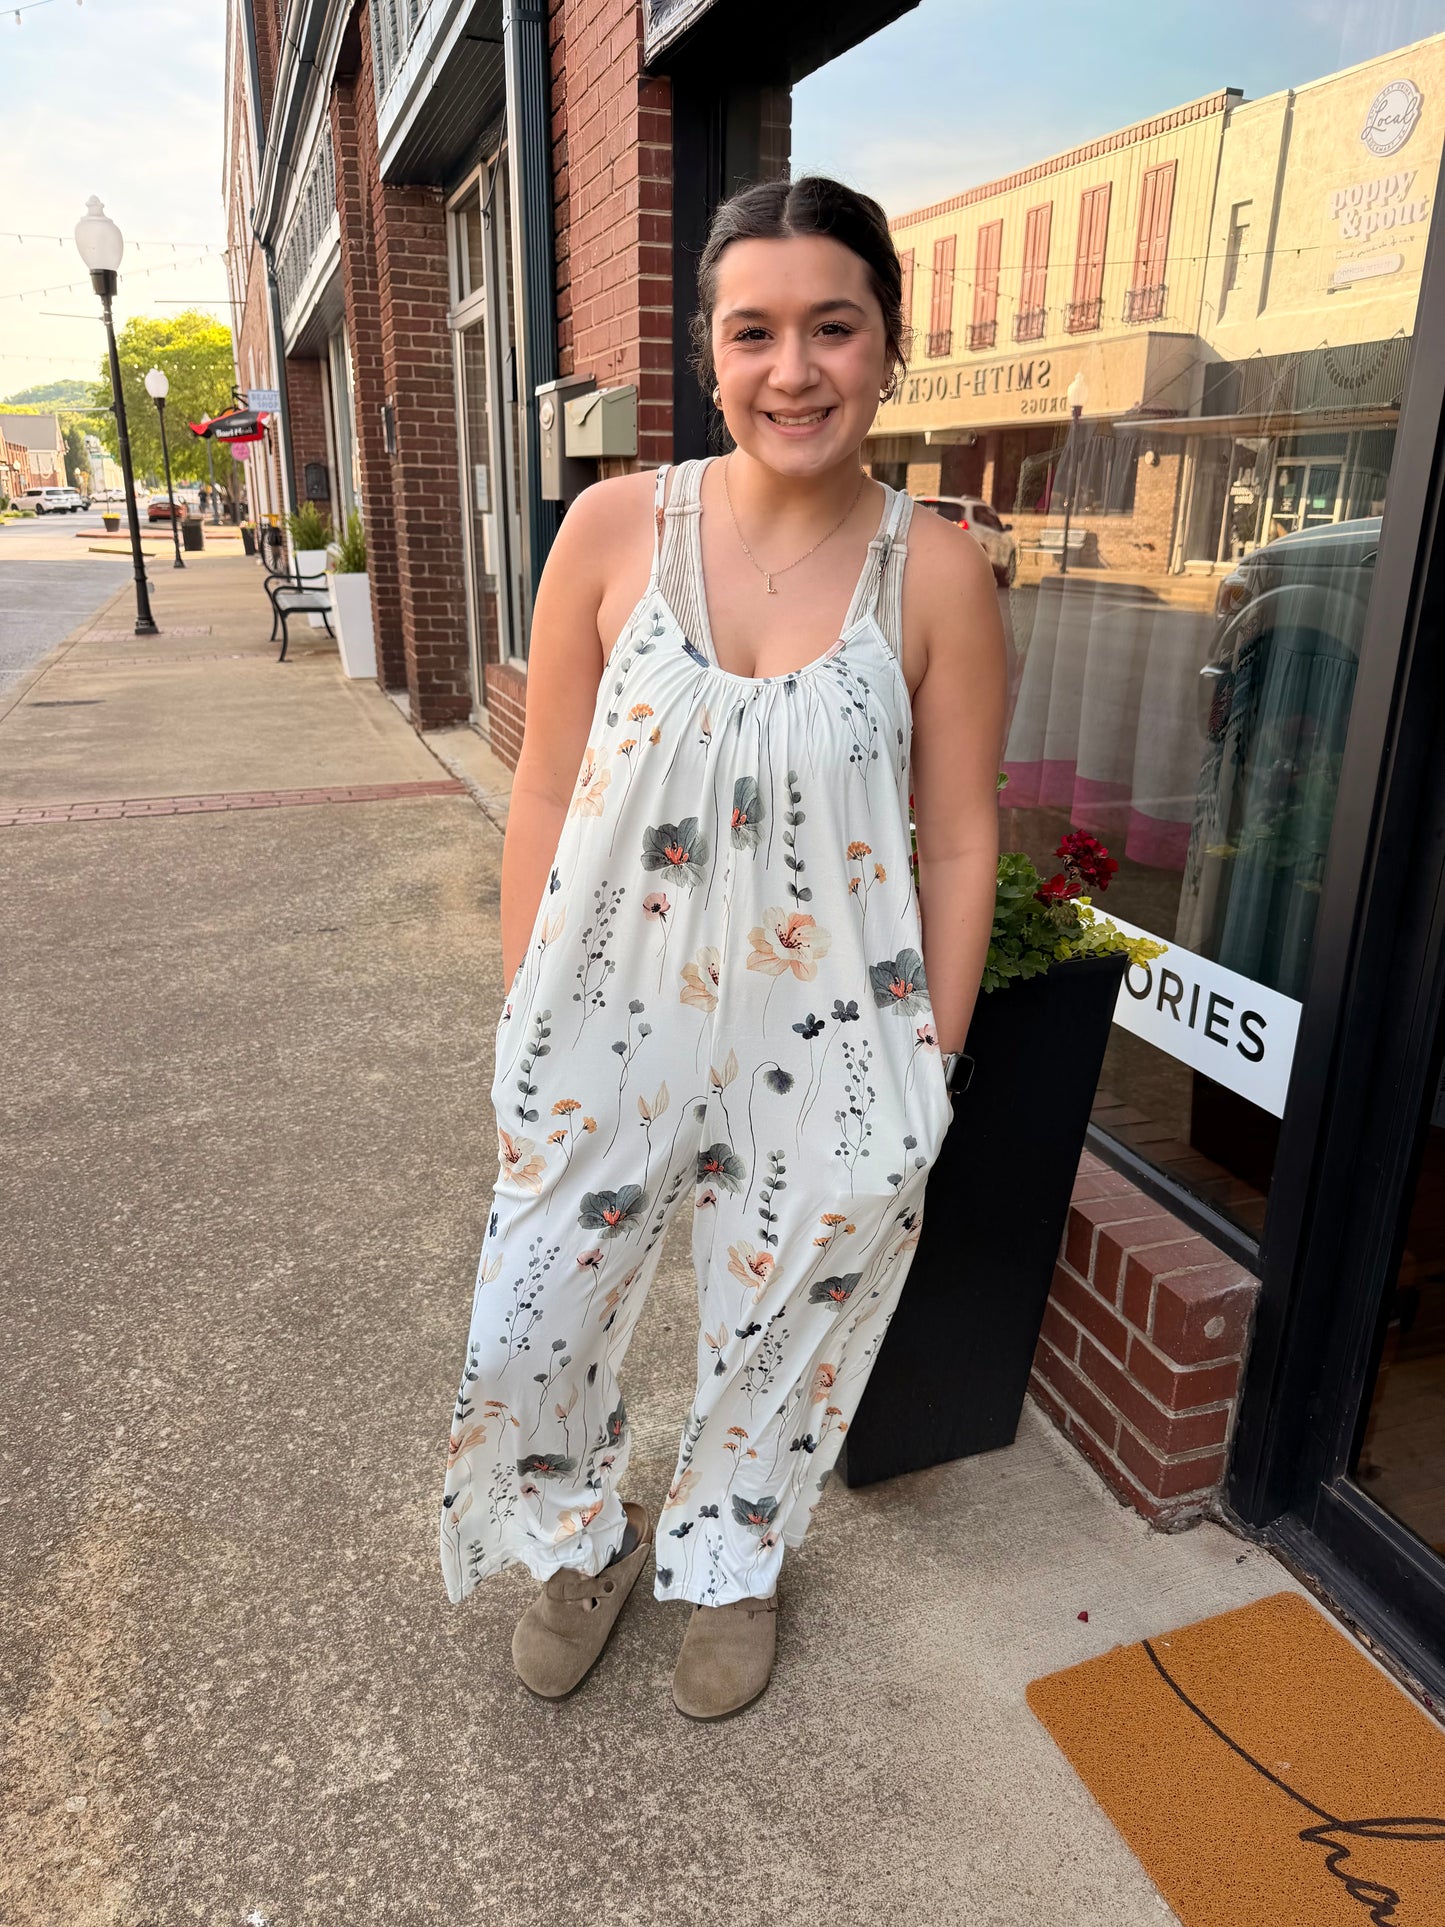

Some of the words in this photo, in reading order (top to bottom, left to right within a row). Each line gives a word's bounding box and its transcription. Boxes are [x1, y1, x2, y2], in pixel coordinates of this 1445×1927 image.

[1361, 96, 1418, 140] Local
[1330, 169, 1418, 220] poppy
[251, 393, 279, 401] BEAUT
[1124, 960, 1267, 1063] ORIES
